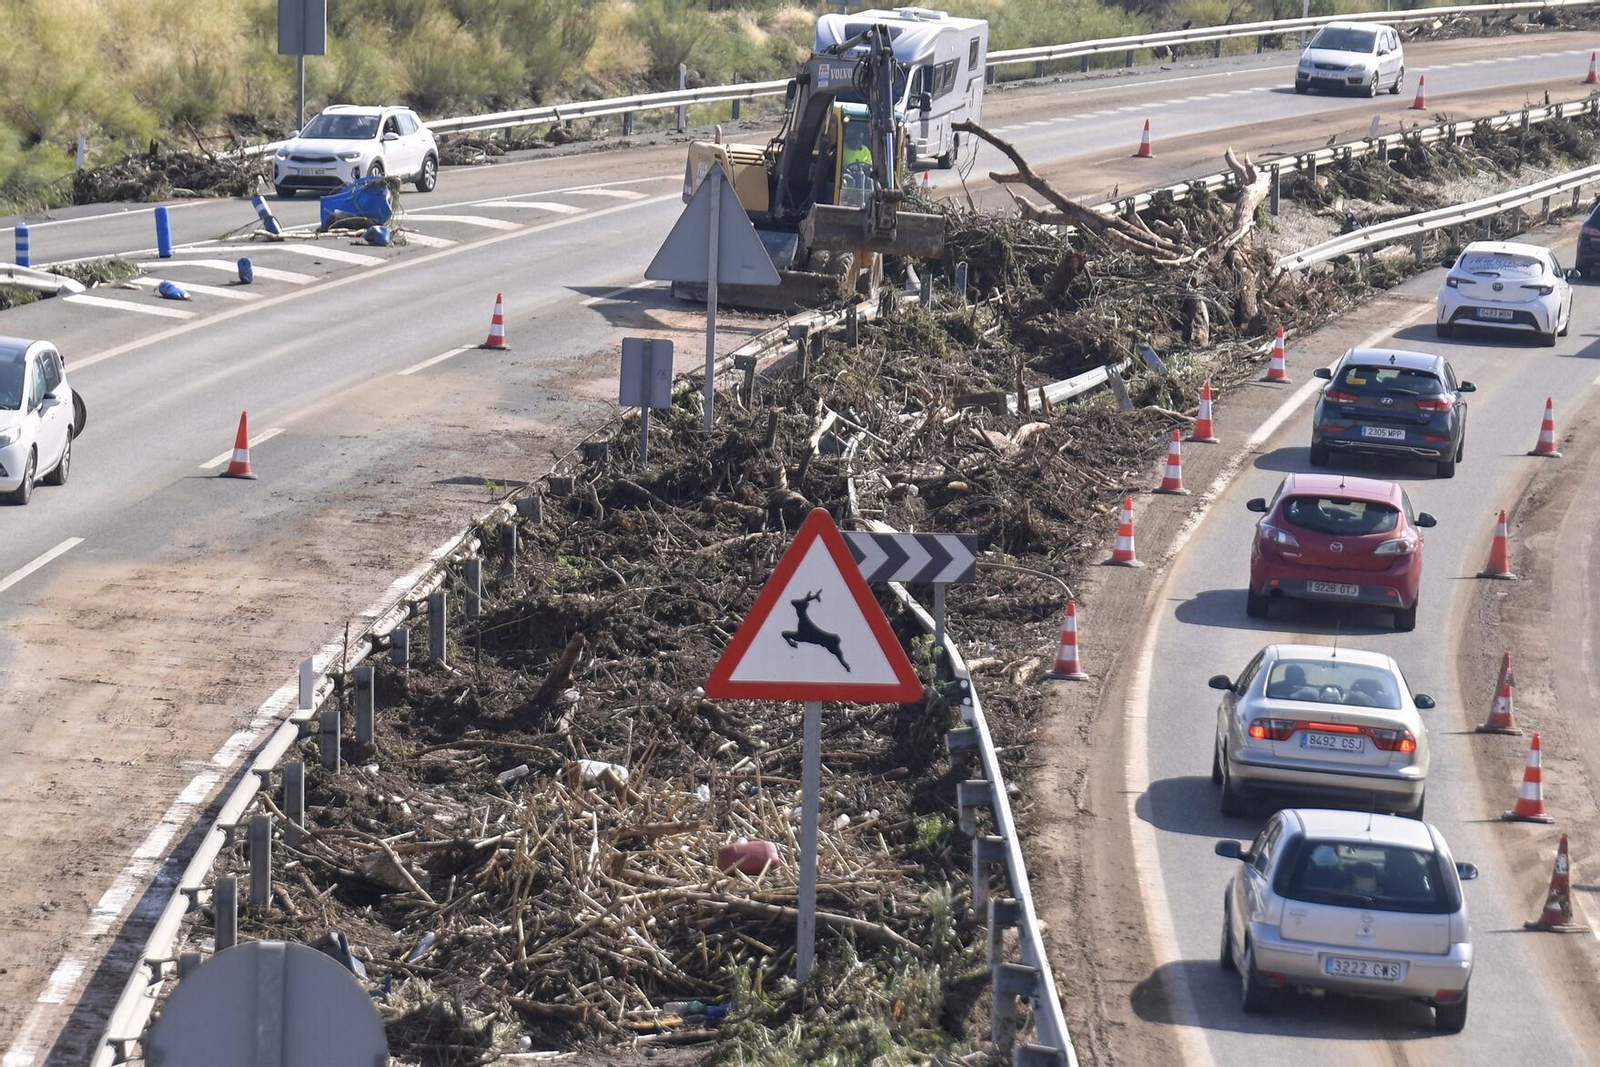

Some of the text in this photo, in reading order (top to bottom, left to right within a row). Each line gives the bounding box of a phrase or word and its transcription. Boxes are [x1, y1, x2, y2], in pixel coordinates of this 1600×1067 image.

[831, 67, 853, 79] VOLVO
[1368, 428, 1402, 438] 2305 MPP
[1309, 736, 1363, 750] 8492 CSJ
[1334, 960, 1367, 975] 3222
